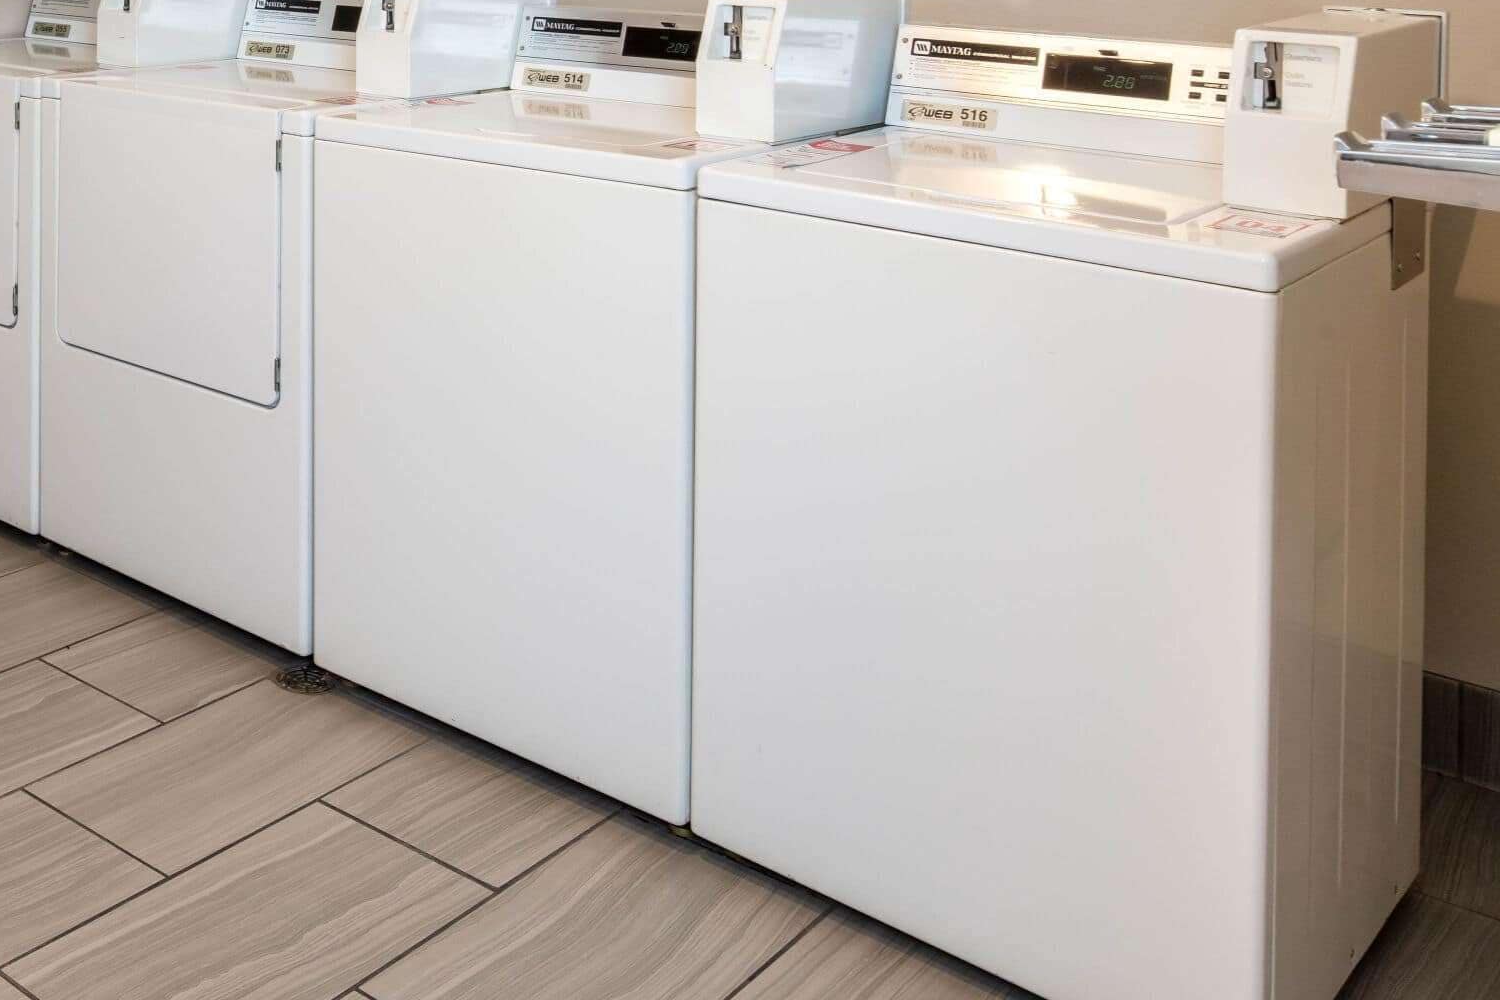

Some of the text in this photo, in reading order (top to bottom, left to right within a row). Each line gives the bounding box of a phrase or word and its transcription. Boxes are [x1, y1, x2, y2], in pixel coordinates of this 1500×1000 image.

[546, 22, 576, 31] MAYTAG
[275, 44, 290, 54] 073
[930, 45, 972, 56] MAYTAG
[537, 73, 584, 84] WEB 514
[923, 107, 988, 122] WEB 516
